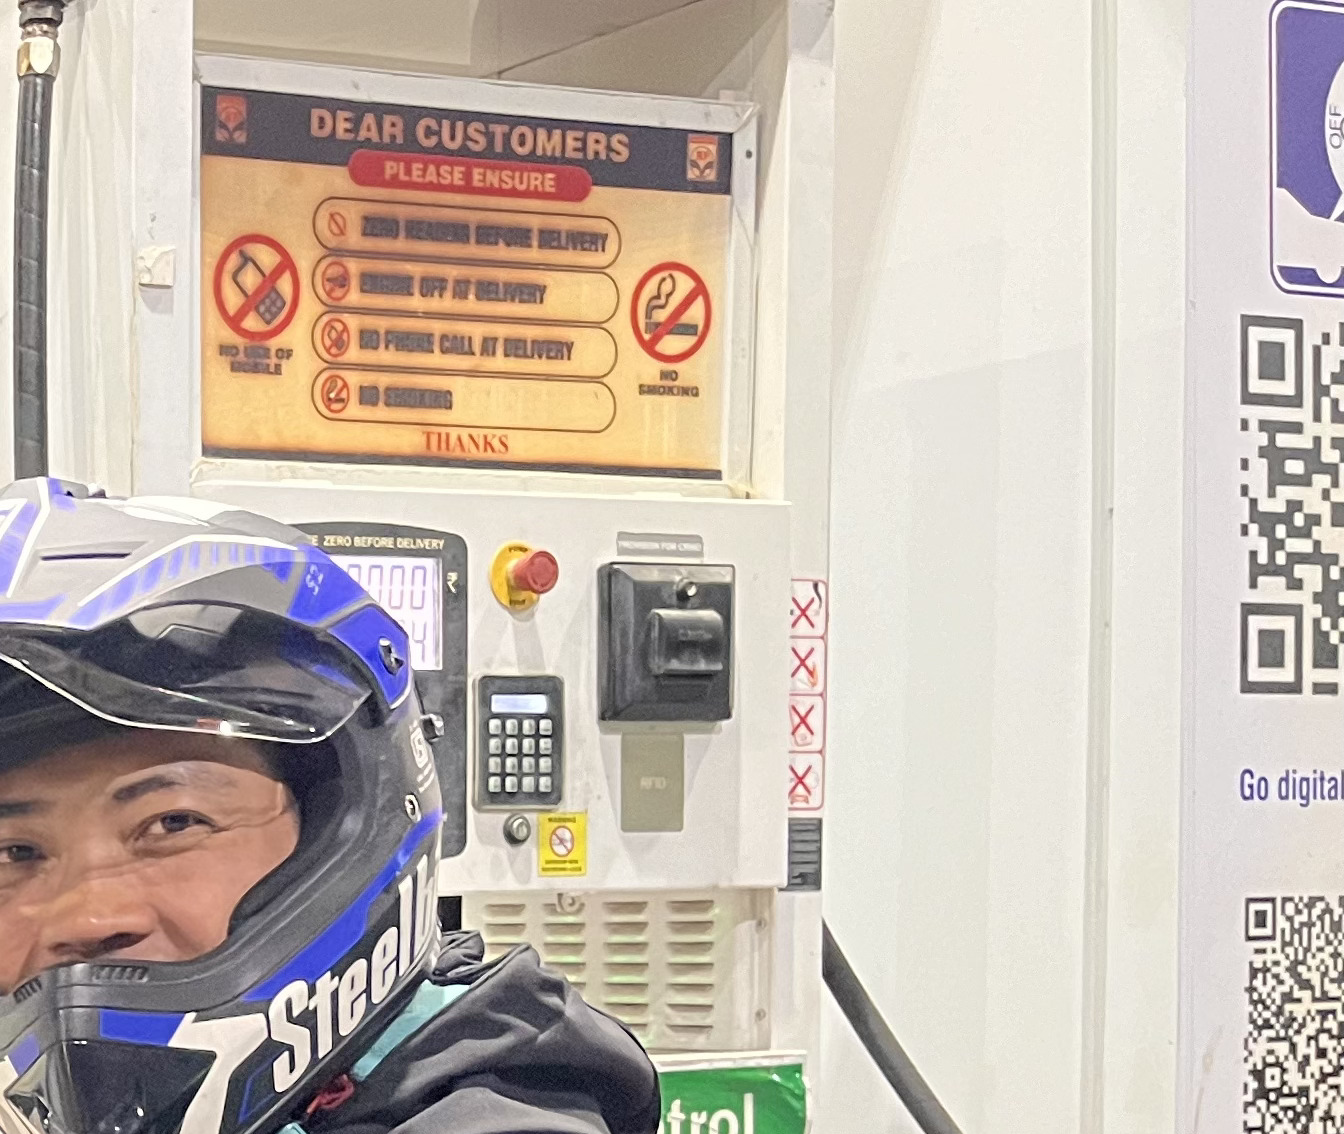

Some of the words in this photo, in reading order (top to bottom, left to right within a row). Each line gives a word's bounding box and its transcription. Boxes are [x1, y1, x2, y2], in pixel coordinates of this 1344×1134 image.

[311, 108, 404, 145] DEAR
[416, 117, 630, 163] CUSTOMERS
[384, 161, 466, 187] PLEASE
[472, 167, 557, 194] ENSURE
[421, 430, 510, 456] THANKS
[323, 535, 352, 547] ZERO
[353, 536, 395, 548] BEFORE
[396, 537, 445, 550] DELIVERY
[1239, 768, 1269, 801] Go
[1277, 768, 1344, 808] digital
